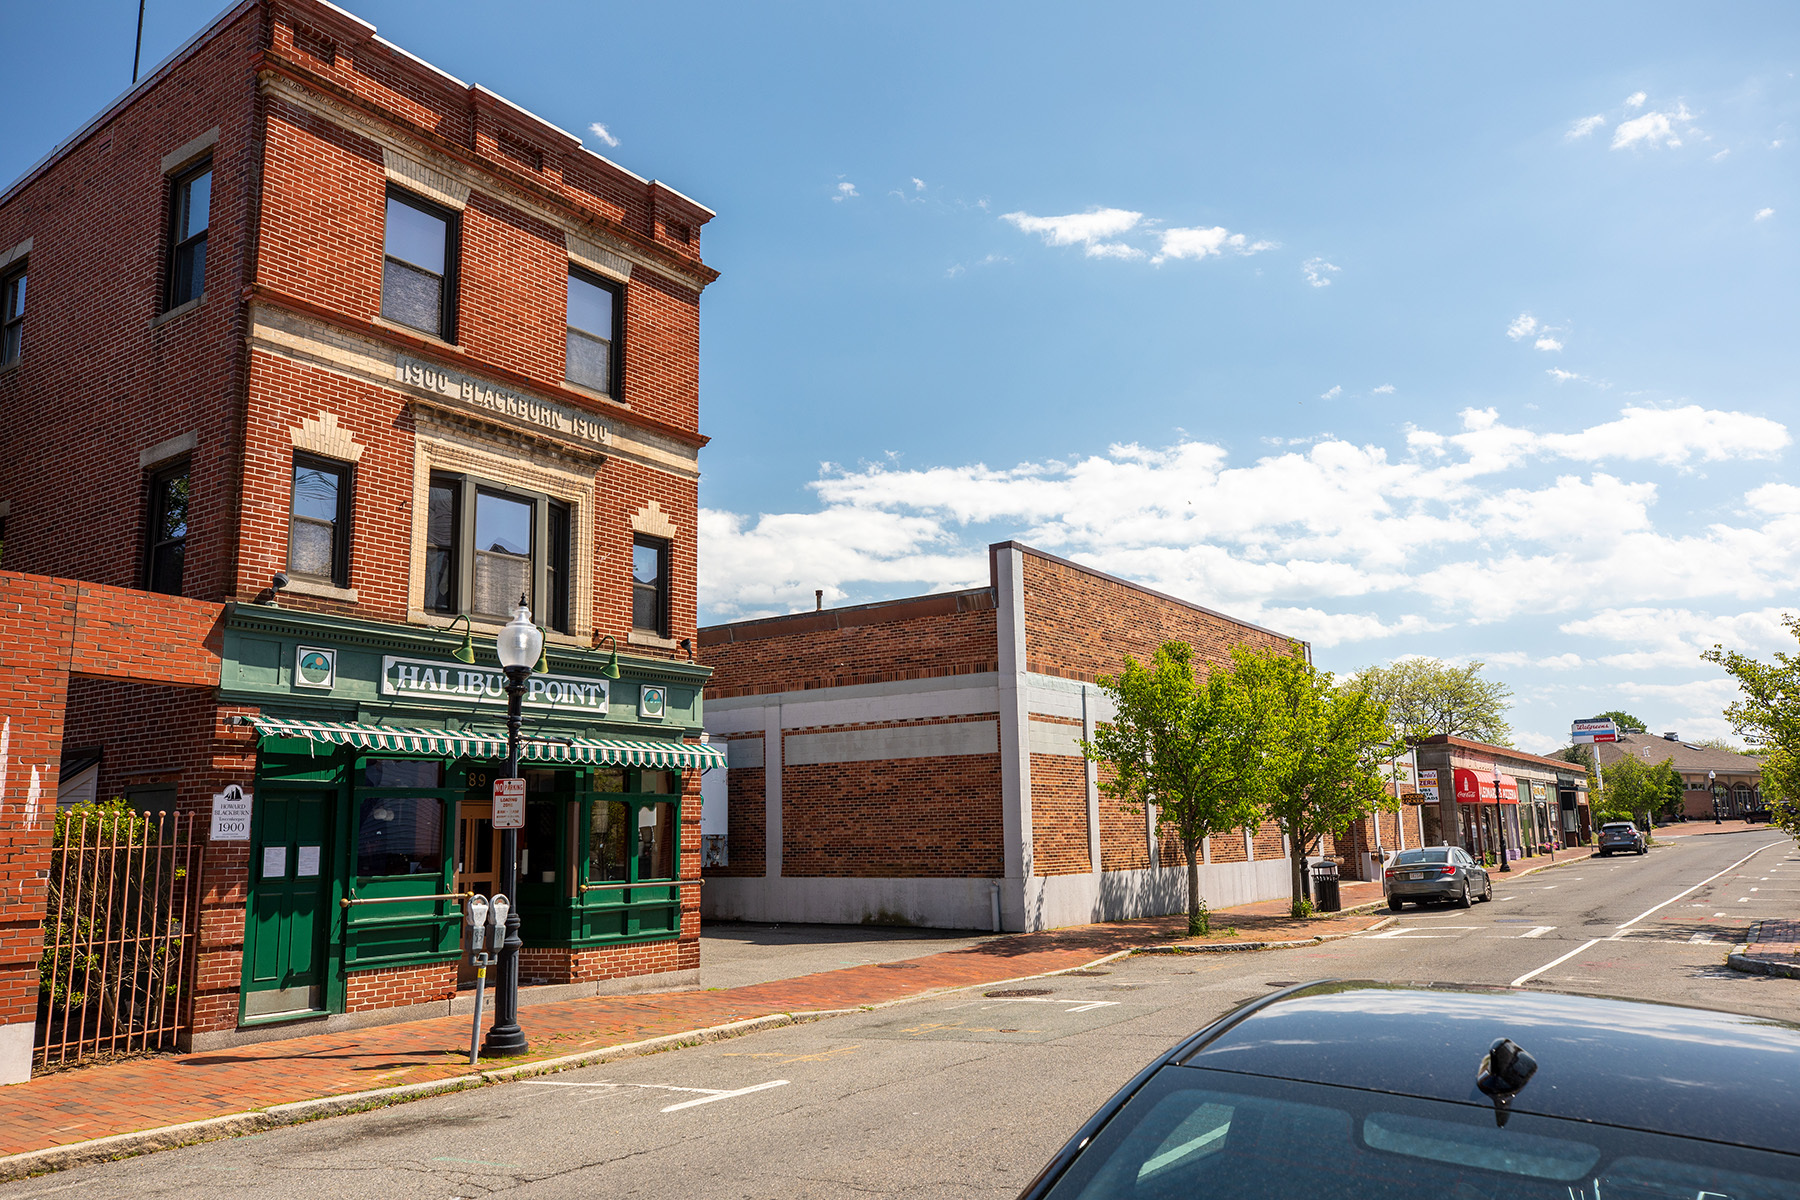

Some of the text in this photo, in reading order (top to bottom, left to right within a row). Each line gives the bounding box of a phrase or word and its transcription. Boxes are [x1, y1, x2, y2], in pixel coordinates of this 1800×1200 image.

[402, 360, 609, 442] 1900 BLACKBURN 1900
[397, 665, 601, 706] HALIBU POINT
[469, 772, 486, 787] 89
[495, 783, 504, 793] NO
[218, 822, 245, 832] 1900
